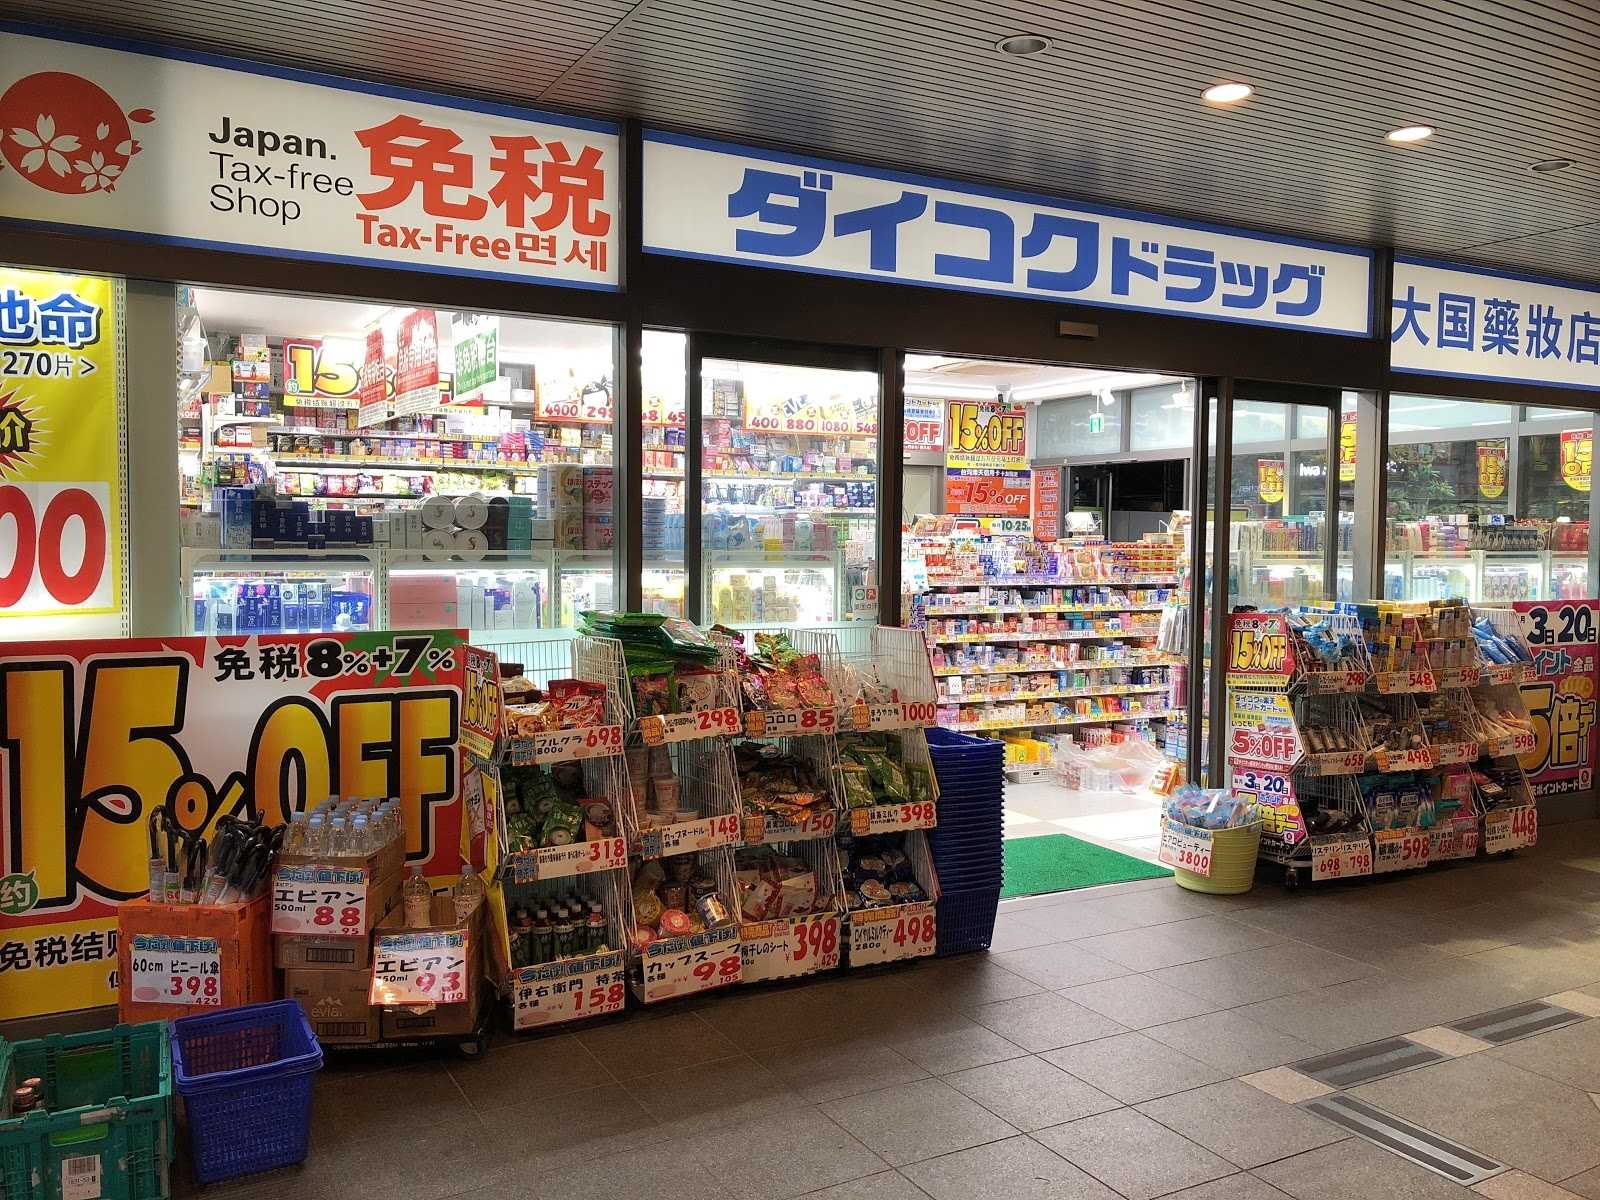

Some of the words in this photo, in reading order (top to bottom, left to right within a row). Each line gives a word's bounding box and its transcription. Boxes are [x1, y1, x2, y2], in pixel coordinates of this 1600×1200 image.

[208, 117, 337, 161] Japan.
[209, 150, 354, 197] Tax-free
[354, 114, 611, 237] 免税
[209, 184, 302, 224] Shop
[355, 213, 511, 259] Tax-Free
[515, 234, 608, 272] 면세
[728, 167, 1324, 319] ダイコクドラッグ
[786, 419, 815, 430] 880
[1005, 494, 1028, 504] OFF
[1408, 672, 1434, 687] 548
[698, 708, 737, 730] 298
[800, 709, 835, 728] 85
[901, 703, 935, 721] 1000
[586, 726, 621, 748] 698
[1231, 728, 1297, 761] 5%OFF
[1514, 734, 1534, 749] 598
[1407, 750, 1430, 764] 498
[900, 802, 934, 823] 398
[1512, 806, 1535, 838] 448
[708, 815, 738, 837] 148
[589, 838, 625, 861] 318
[1178, 849, 1209, 870] 3800
[1401, 837, 1430, 860] 598
[1320, 857, 1340, 873] 698
[1349, 854, 1370, 868] 798
[275, 889, 365, 905] エビアン
[313, 906, 361, 926] 88
[342, 927, 359, 935] 95
[793, 918, 837, 961] 398
[893, 914, 935, 947] 498
[132, 958, 163, 972] 60cm
[170, 959, 220, 975] ビニール傘
[375, 956, 465, 974] エビアン
[692, 955, 742, 981] 98
[169, 975, 218, 997] 398
[415, 971, 461, 993] 93
[573, 983, 625, 1010] 158
